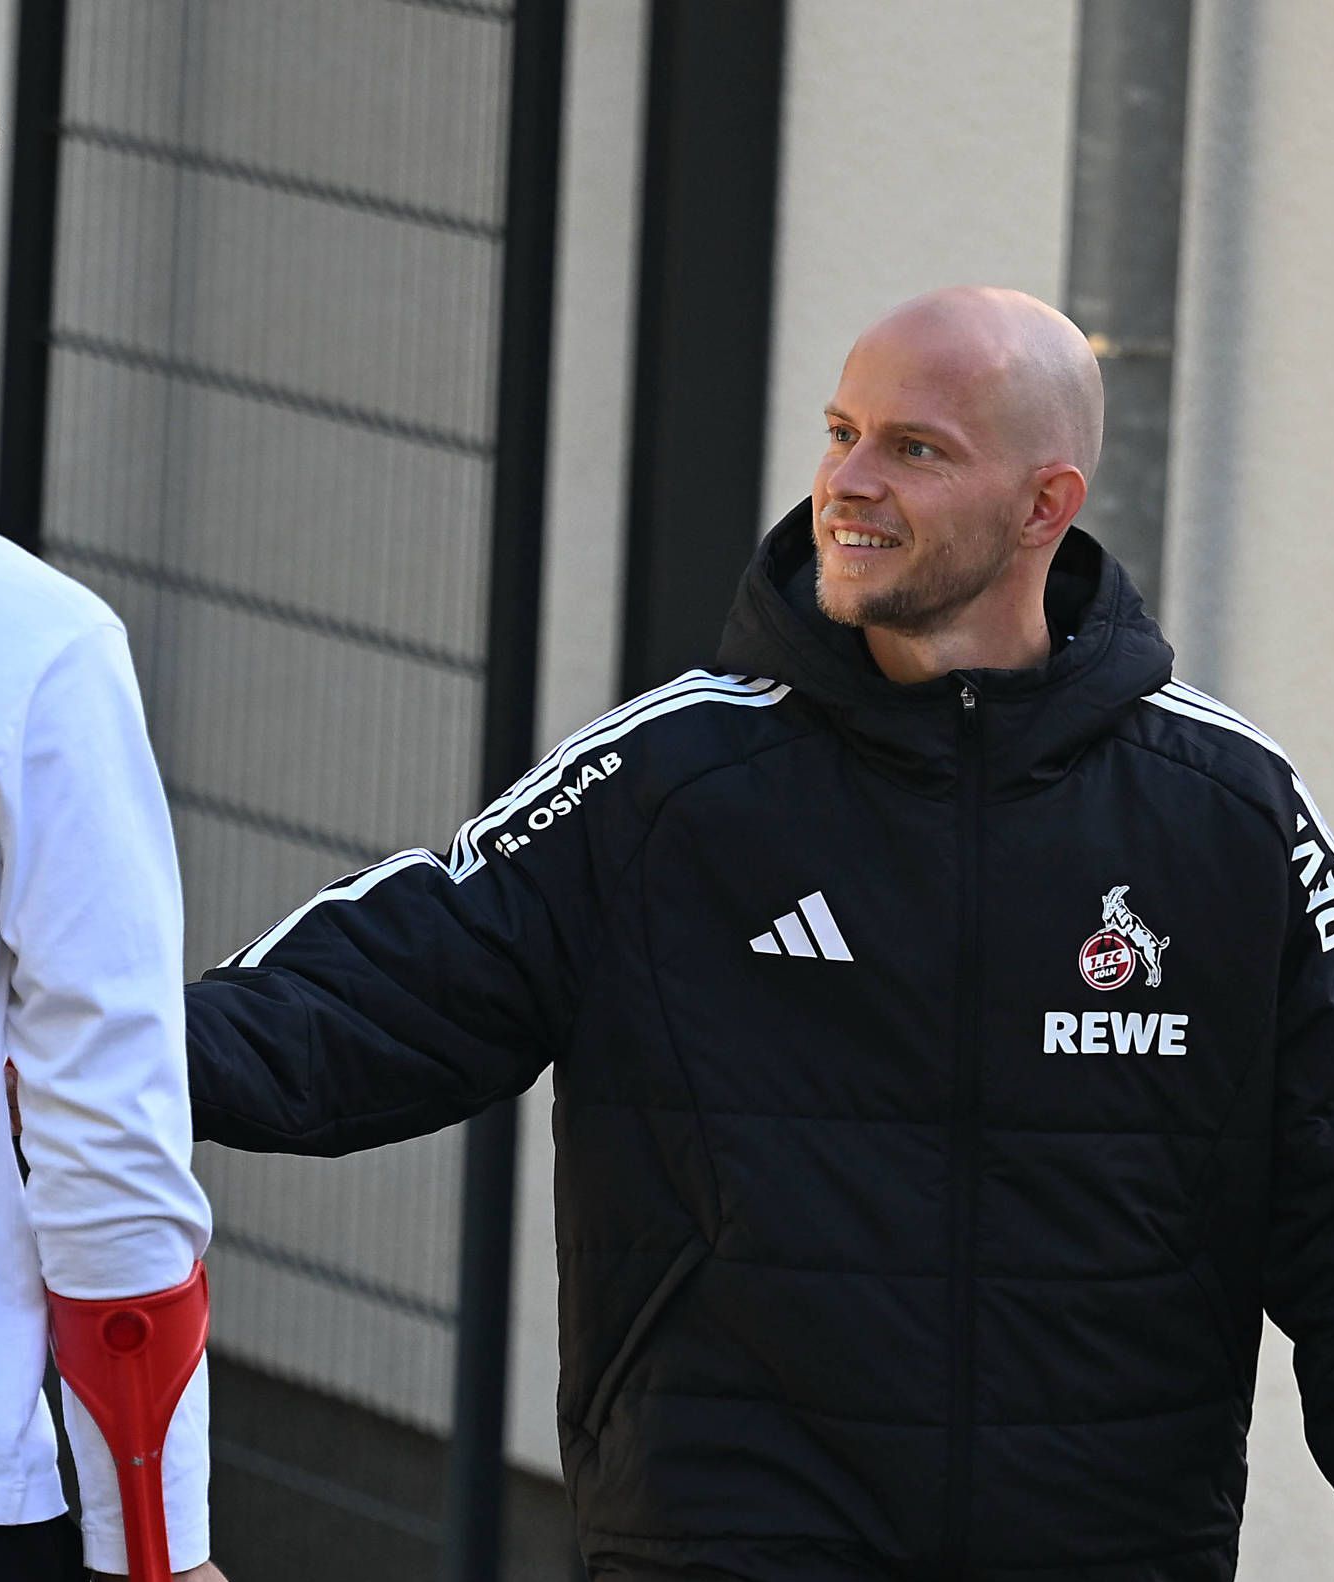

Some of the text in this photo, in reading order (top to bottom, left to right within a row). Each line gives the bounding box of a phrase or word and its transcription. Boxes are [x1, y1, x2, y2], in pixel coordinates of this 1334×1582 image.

[527, 751, 623, 831] OSMAB
[1090, 951, 1122, 968] 1.FC
[1043, 1011, 1189, 1056] REWE
